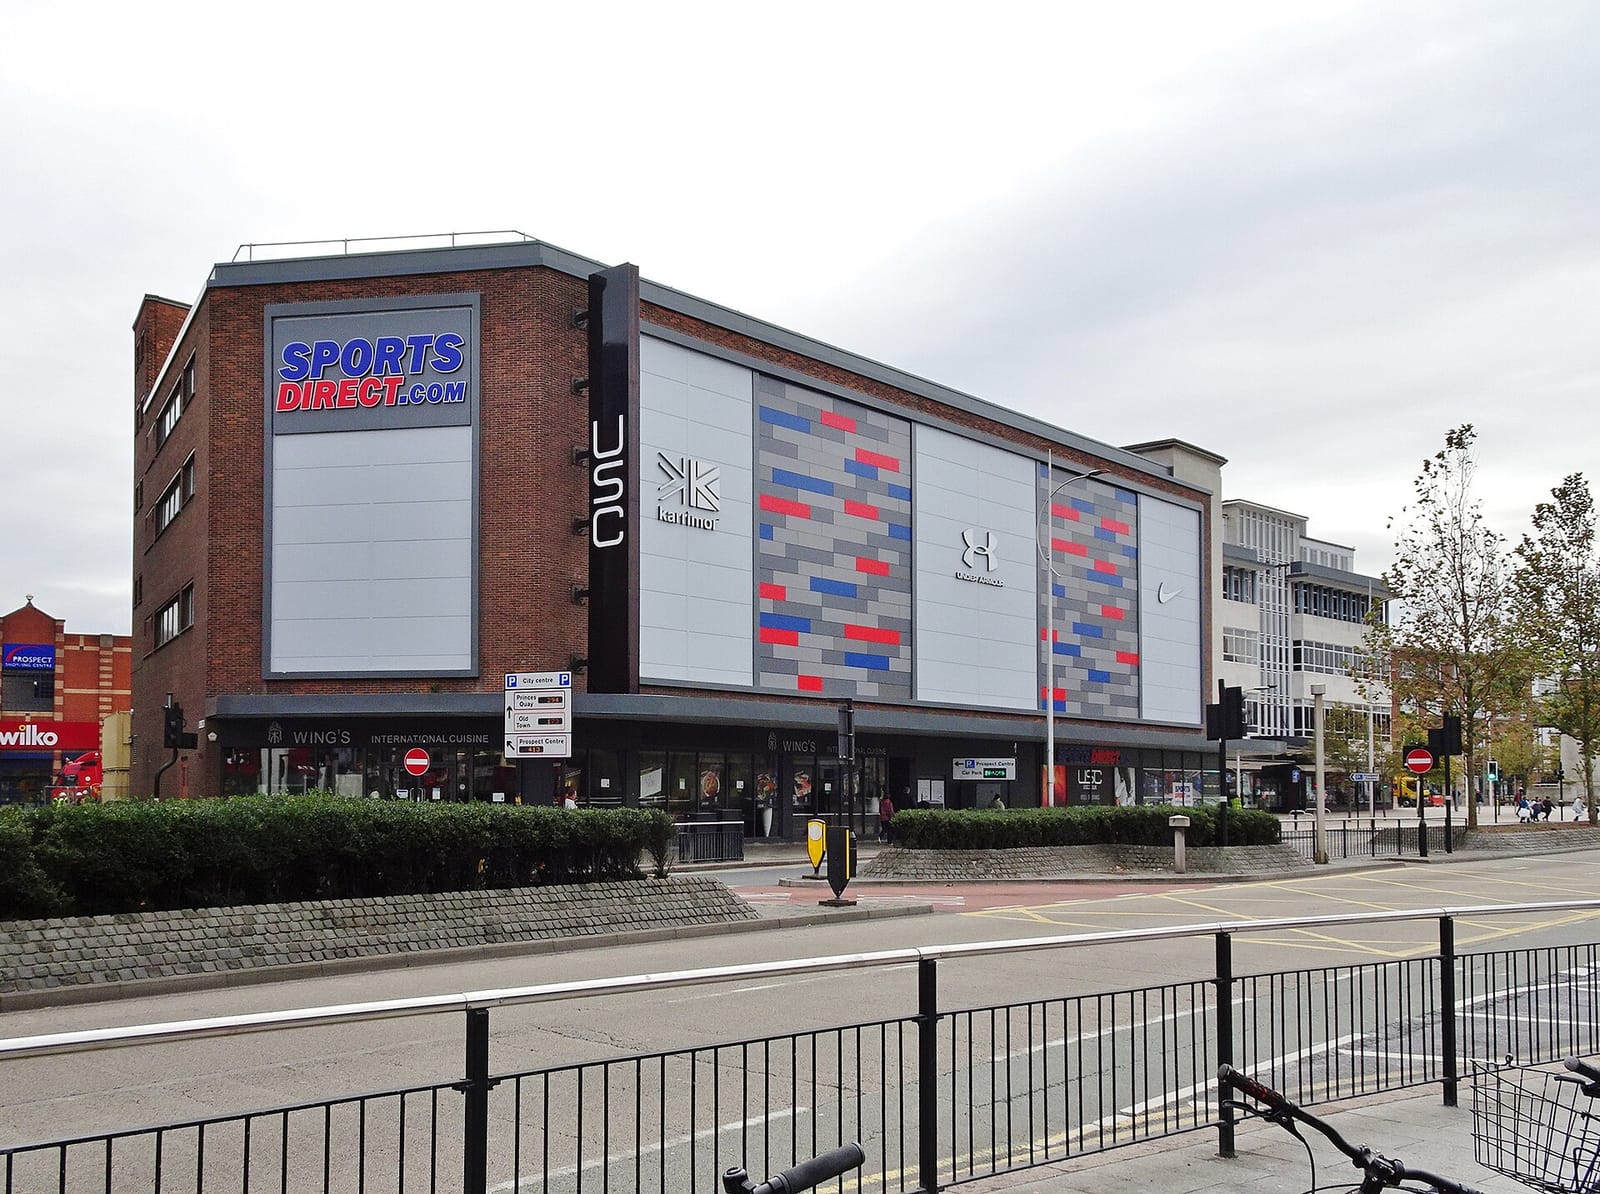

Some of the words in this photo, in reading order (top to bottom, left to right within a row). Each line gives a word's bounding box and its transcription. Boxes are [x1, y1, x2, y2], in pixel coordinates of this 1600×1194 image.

[278, 332, 466, 381] SPORTS
[658, 505, 719, 531] karrimor
[12, 656, 52, 664] PROSPECT
[0, 724, 58, 746] wilko
[293, 728, 351, 744] WING'S
[371, 735, 447, 743] INTERNATIONAL
[449, 734, 488, 743] CUISINE
[782, 739, 816, 753] WING'S
